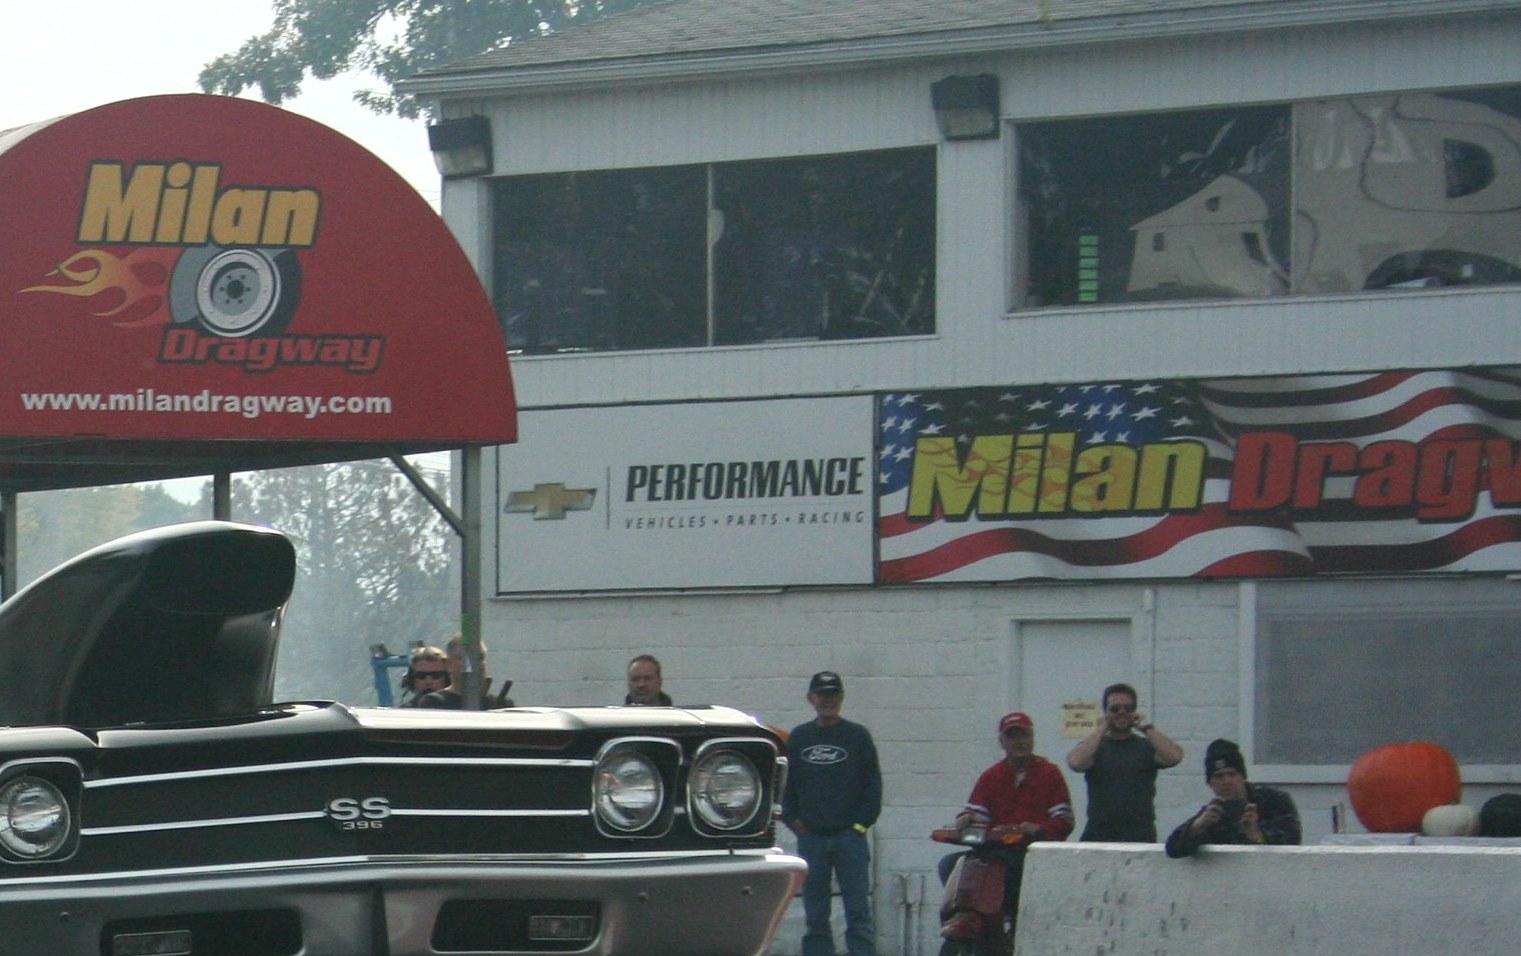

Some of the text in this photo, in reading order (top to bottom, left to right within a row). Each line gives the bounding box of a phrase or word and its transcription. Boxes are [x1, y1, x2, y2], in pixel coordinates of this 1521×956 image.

[77, 161, 323, 248] Milan
[159, 324, 385, 373] Dragway
[21, 388, 392, 418] www.milandragway.com
[625, 457, 866, 502] PERFORMANCE
[906, 430, 1207, 521] Milan
[625, 511, 866, 529] VEHICLES PARTS RACING
[329, 797, 391, 820] SS
[342, 821, 383, 830] 396
